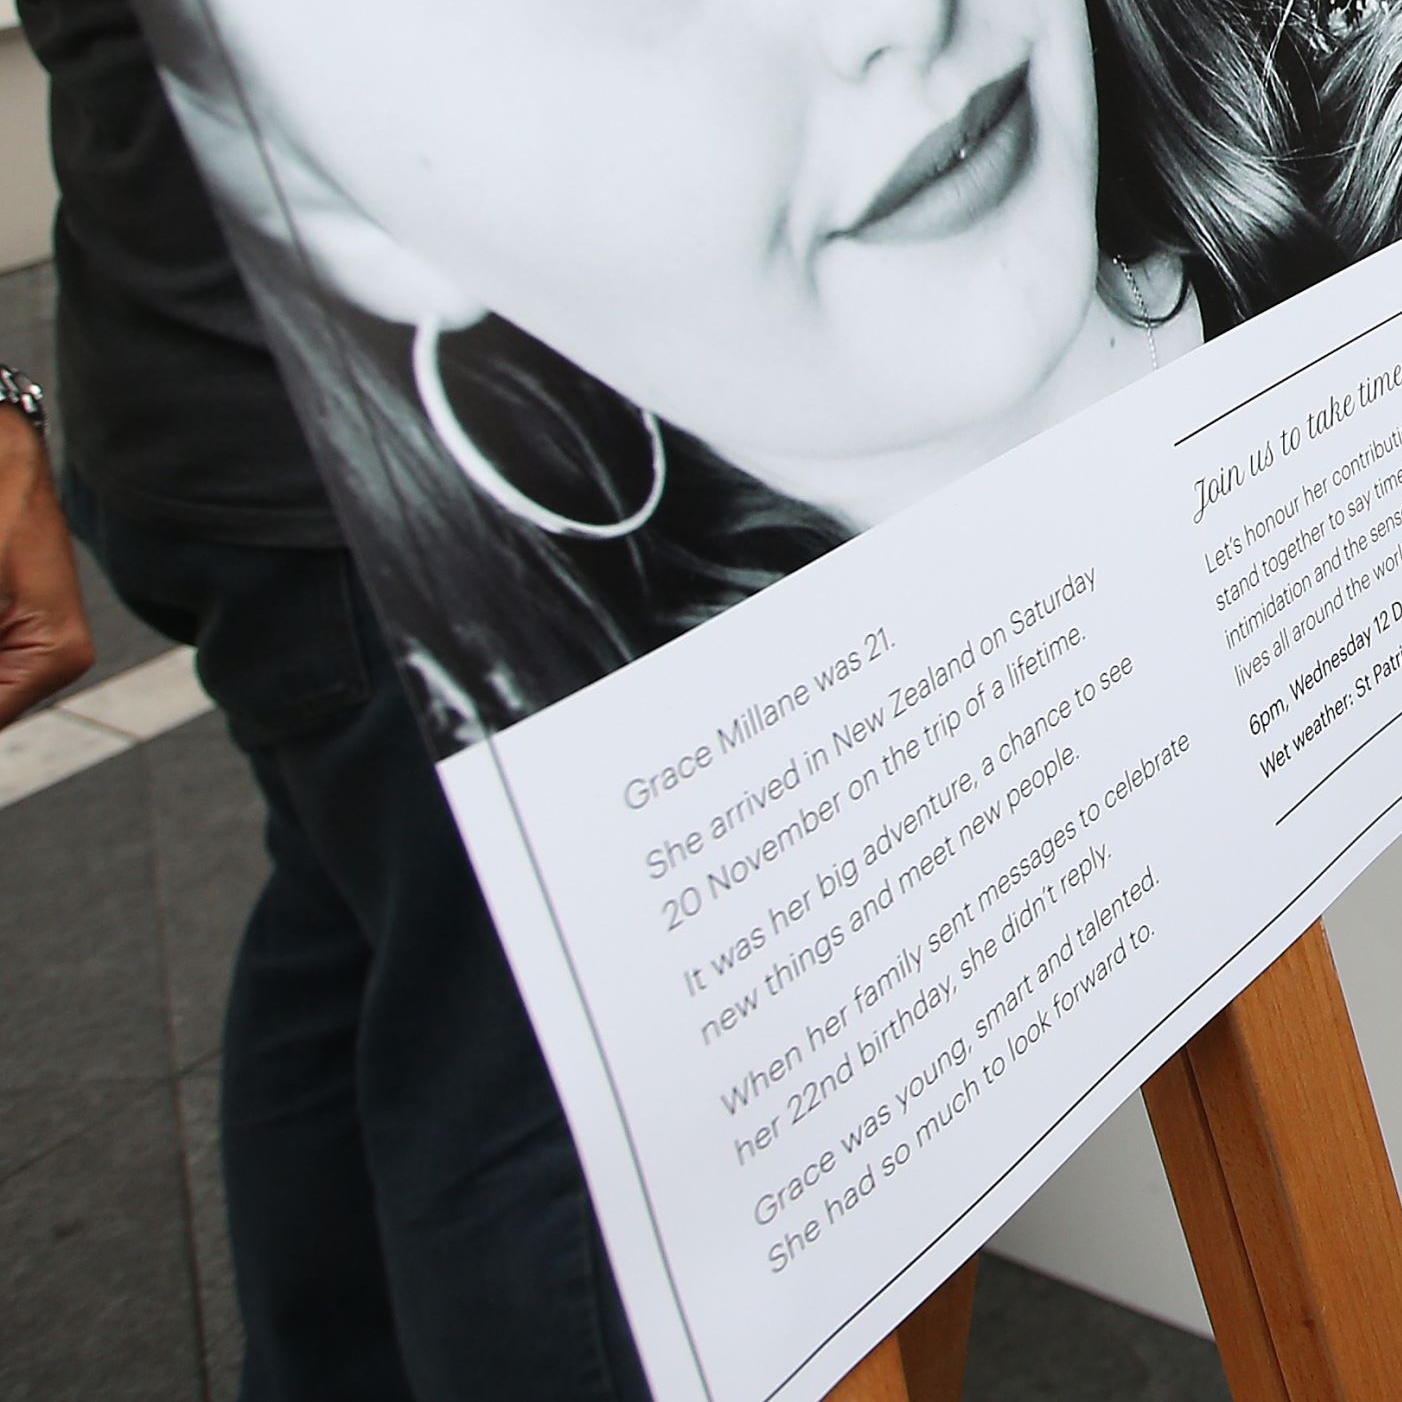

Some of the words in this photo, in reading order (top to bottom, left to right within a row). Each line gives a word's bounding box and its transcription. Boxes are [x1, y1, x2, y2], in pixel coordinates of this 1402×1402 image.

[1192, 464, 1246, 525] Join
[1249, 439, 1274, 477] us
[1279, 426, 1301, 457] to
[1305, 393, 1356, 440] take
[1204, 535, 1243, 575] Let's
[1243, 496, 1300, 547] honour
[1301, 477, 1328, 507] her
[1215, 562, 1261, 612] stand
[1261, 520, 1325, 578] together
[1327, 509, 1345, 531] to
[1347, 489, 1371, 518] say
[1223, 574, 1313, 651] intimidation
[1313, 545, 1343, 583] and
[1342, 534, 1369, 562] the
[1233, 649, 1271, 688] lives
[1272, 627, 1291, 658] all
[1291, 585, 1345, 643] around
[1345, 573, 1371, 601] the
[1249, 698, 1290, 736] 6pm,
[1288, 625, 1371, 701] Wednesday
[1372, 609, 1391, 635] 12
[623, 744, 715, 811] Grace
[715, 683, 812, 756] Millane
[812, 650, 864, 694] was
[862, 625, 897, 664] 21.
[645, 830, 706, 881] She
[708, 756, 803, 841] arrived
[801, 746, 831, 777] in
[830, 705, 885, 758] New
[886, 638, 977, 720] Zealand
[978, 626, 1009, 657] on
[1008, 565, 1096, 637] Saturday
[660, 885, 703, 933] 20
[705, 790, 842, 900] November
[847, 767, 881, 802] on
[880, 737, 922, 777] the
[921, 708, 963, 748] trip
[964, 681, 987, 719] of
[979, 678, 1006, 701] a
[1004, 626, 1088, 690] lifetime.
[682, 968, 708, 998] It
[709, 925, 768, 977] was
[766, 888, 812, 937] her
[814, 856, 861, 901] big
[861, 771, 979, 868] adventure,
[980, 755, 997, 778] a
[997, 699, 1073, 764] chance
[1072, 681, 1097, 709] to
[1098, 655, 1135, 692] see
[1259, 742, 1293, 779] Wet
[1291, 693, 1354, 752] weather:
[1354, 674, 1373, 699] St
[700, 986, 759, 1046] new
[762, 923, 847, 998] things
[847, 876, 896, 934] and
[896, 834, 958, 896] meet
[957, 798, 1002, 848] new
[1005, 745, 1081, 816] people.
[719, 1044, 805, 1117] When
[804, 1003, 849, 1054] her
[852, 943, 923, 1016] family
[926, 900, 977, 955] sent
[976, 819, 1078, 917] messages
[1077, 801, 1102, 829] to
[1103, 733, 1191, 810] celebrate
[732, 1114, 781, 1167] her
[785, 1050, 856, 1128] 22nd
[856, 974, 958, 1069] birthday,
[958, 937, 999, 981] she
[1001, 884, 1058, 944] didn't
[1060, 842, 1112, 895] reply.
[753, 1149, 838, 1227] Grace
[839, 1102, 893, 1156] was
[893, 1035, 974, 1117] young,
[974, 973, 1036, 1040] smart
[1035, 931, 1076, 985] and
[1074, 863, 1161, 948] talented.
[766, 1218, 823, 1275] She
[822, 1161, 878, 1227] had
[879, 1141, 912, 1179] so
[914, 1077, 982, 1150] much
[980, 1054, 1007, 1086] to
[1005, 1008, 1054, 1064] look
[1051, 935, 1129, 1021] forward
[1127, 923, 1156, 952] to.
